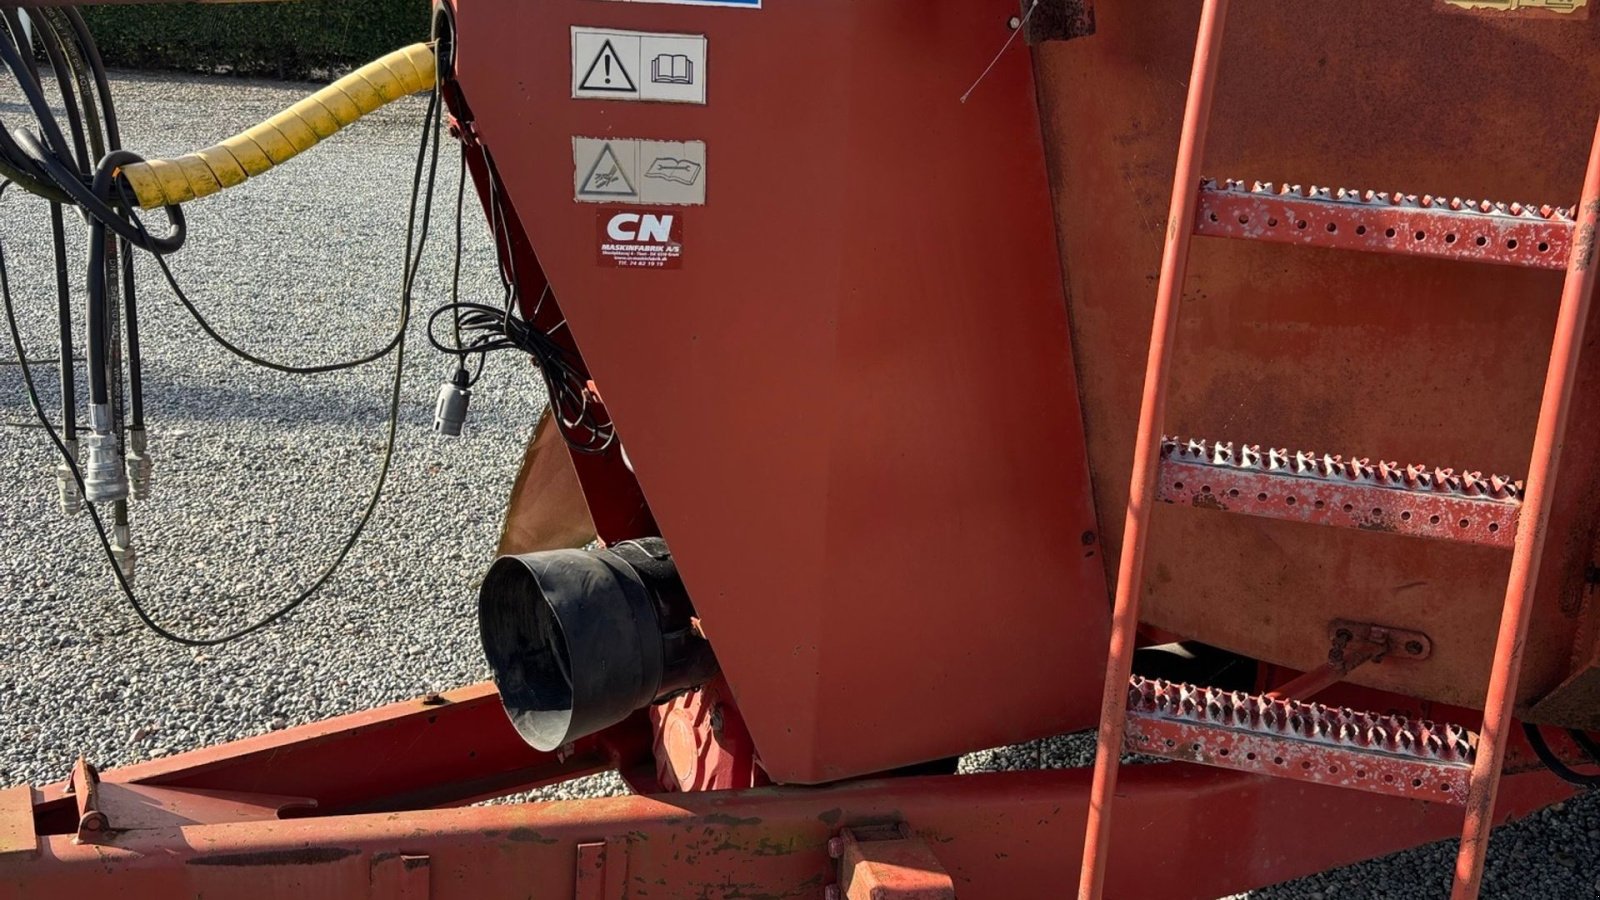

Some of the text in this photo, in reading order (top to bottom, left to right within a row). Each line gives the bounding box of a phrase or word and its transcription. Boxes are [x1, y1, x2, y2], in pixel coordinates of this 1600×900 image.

[606, 212, 674, 242] CN
[601, 244, 680, 253] MASKINFABRIK A/S
